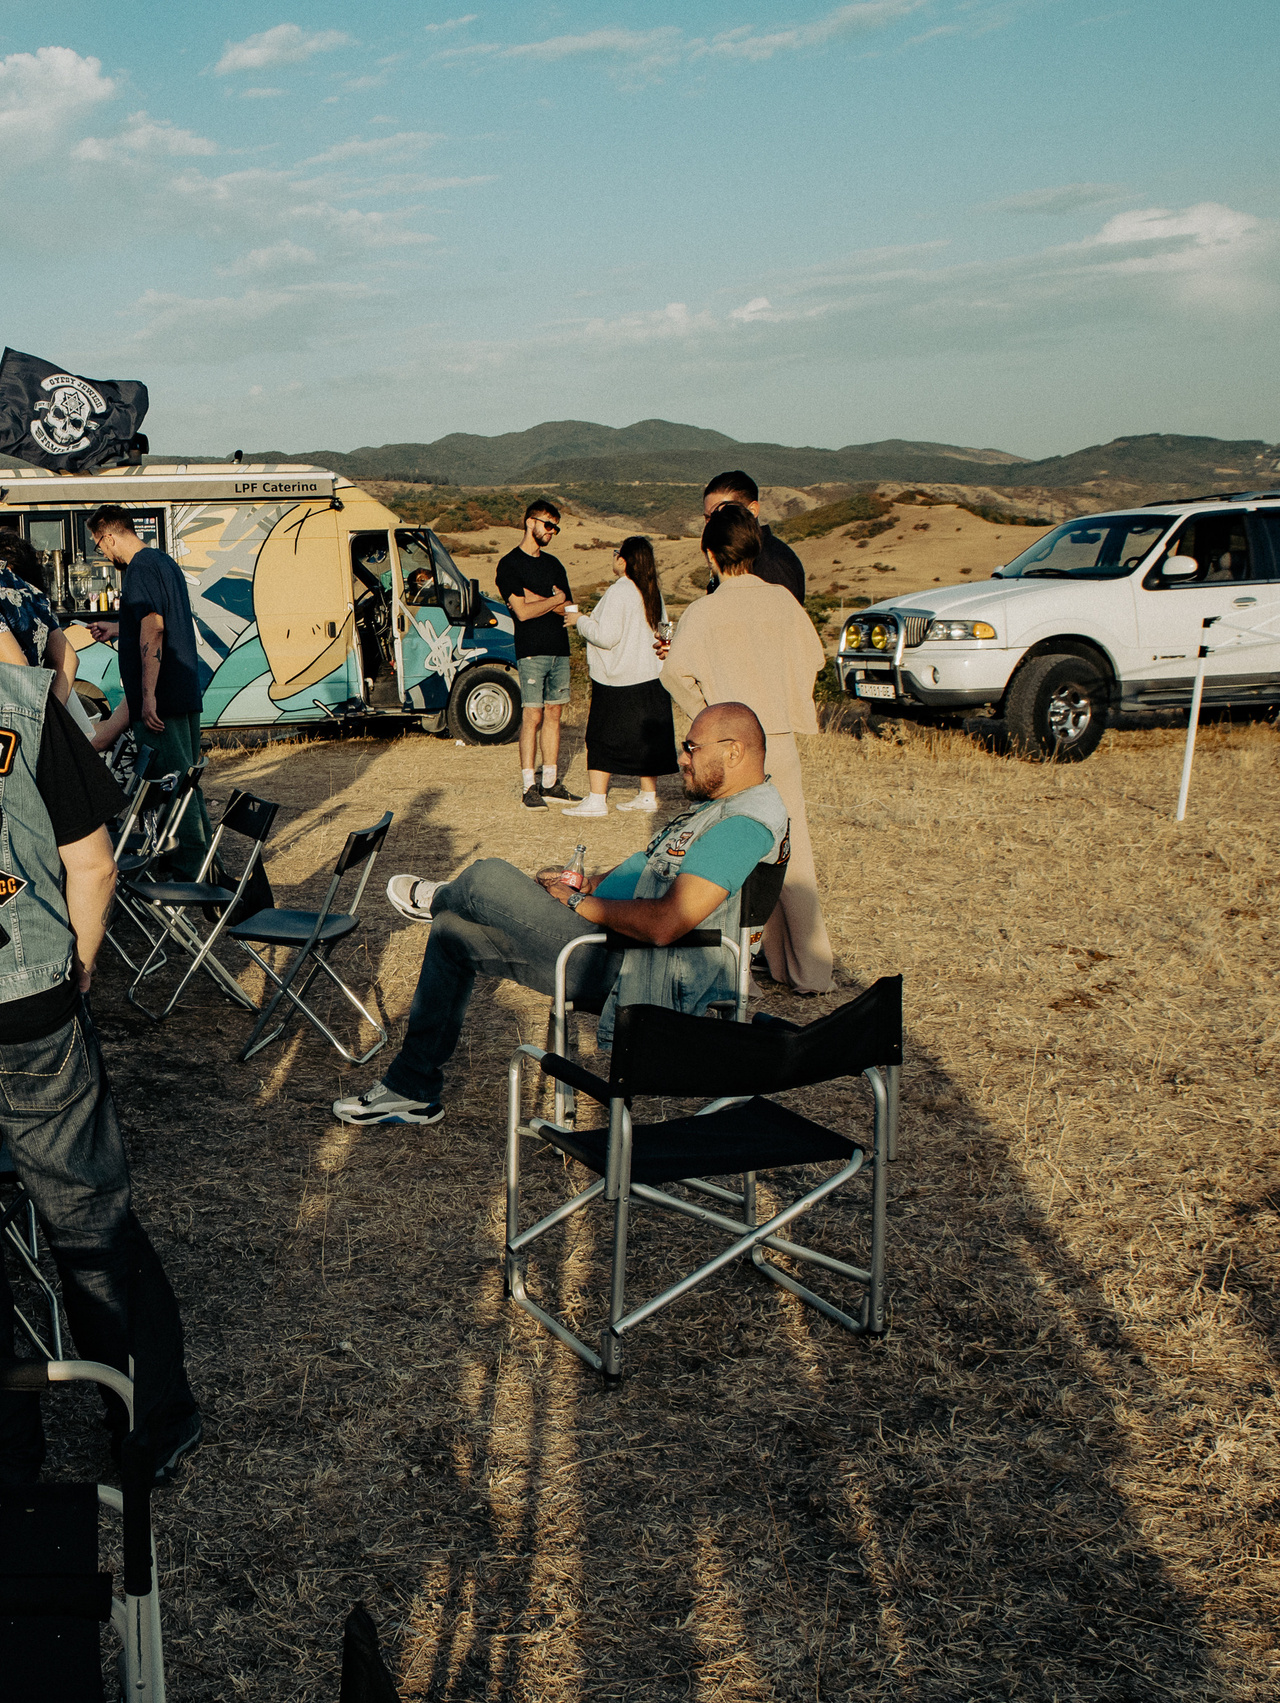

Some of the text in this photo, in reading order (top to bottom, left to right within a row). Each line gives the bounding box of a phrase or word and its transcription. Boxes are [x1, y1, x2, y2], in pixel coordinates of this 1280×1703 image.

[49, 376, 103, 409] GYPSY JEWISH
[235, 483, 258, 493] LPF
